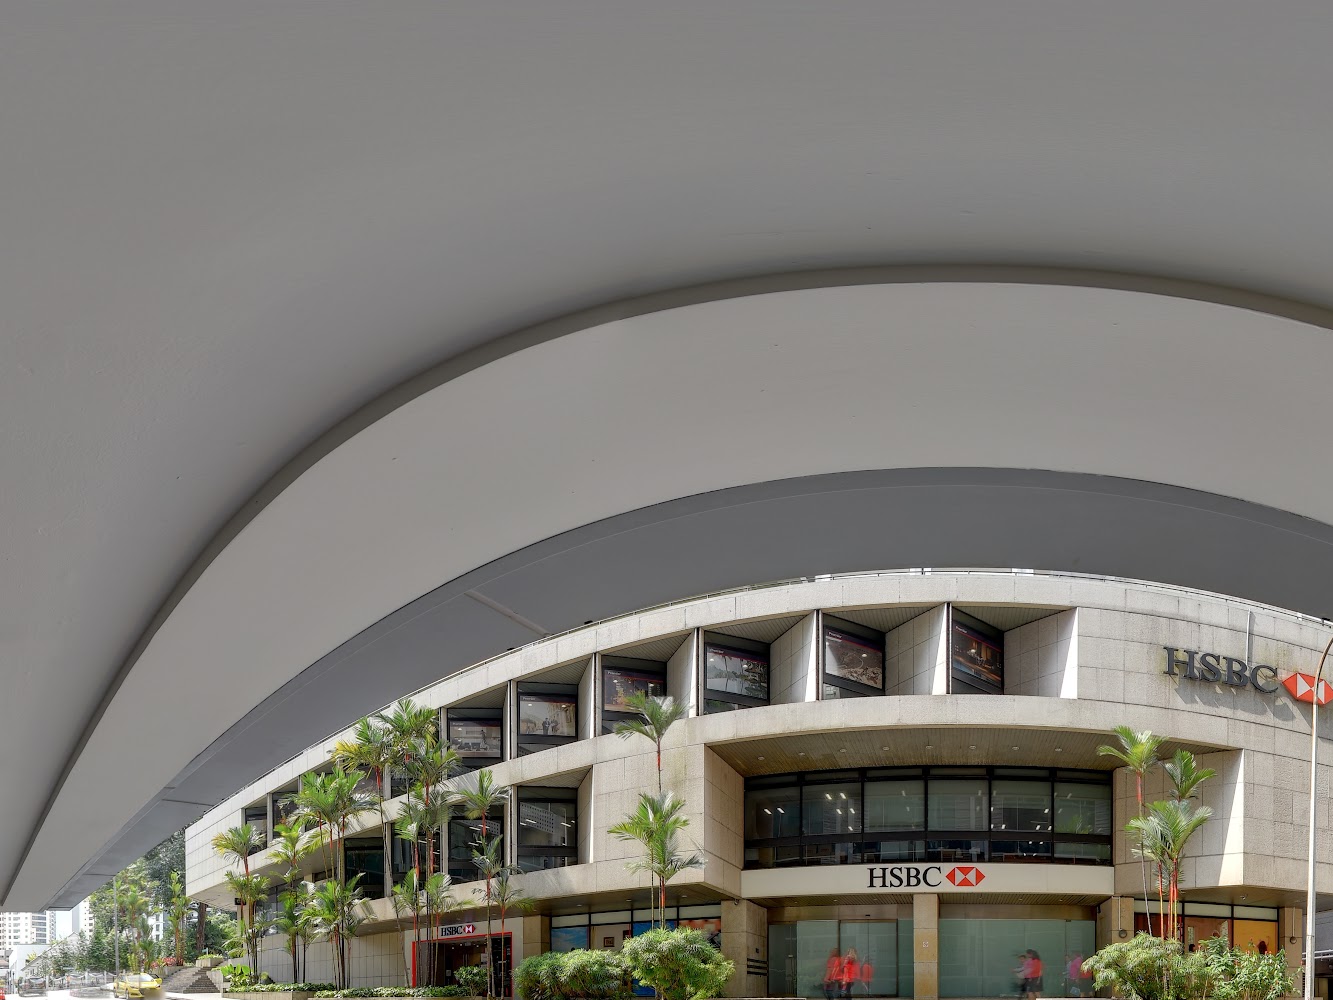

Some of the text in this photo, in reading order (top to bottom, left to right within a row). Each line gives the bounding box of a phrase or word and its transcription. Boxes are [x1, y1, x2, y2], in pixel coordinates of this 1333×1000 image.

[1162, 646, 1279, 694] HSBC
[867, 866, 942, 888] HSBC
[440, 925, 463, 937] HSBC
